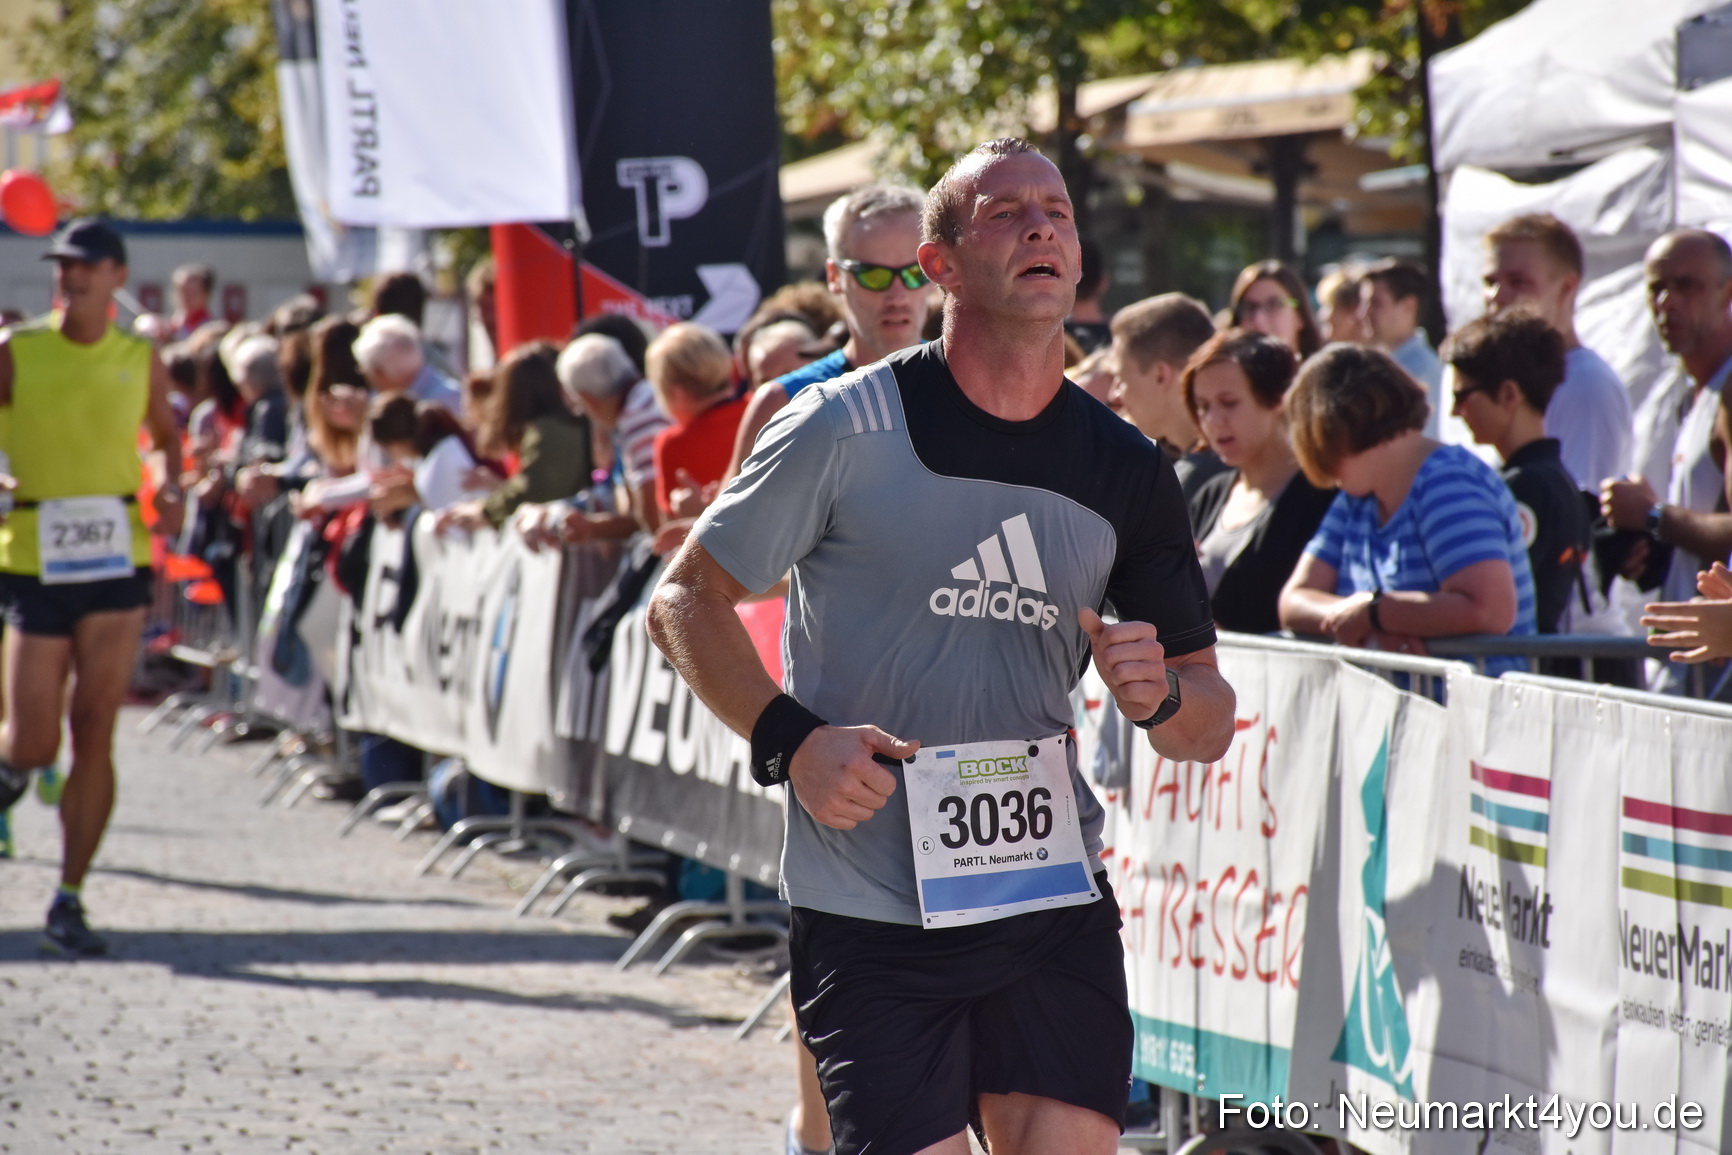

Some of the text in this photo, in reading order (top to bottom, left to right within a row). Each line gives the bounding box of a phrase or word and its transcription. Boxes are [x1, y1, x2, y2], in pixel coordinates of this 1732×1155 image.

[50, 519, 116, 549] 2367
[929, 580, 1059, 631] adidas
[773, 752, 783, 779] adidas
[958, 756, 1028, 778] BOCK
[960, 777, 984, 786] inspired
[985, 776, 992, 784] by
[1010, 774, 1030, 783] concepts
[938, 787, 1053, 849] 3036
[954, 851, 1034, 868] PARTL Neumarkt
